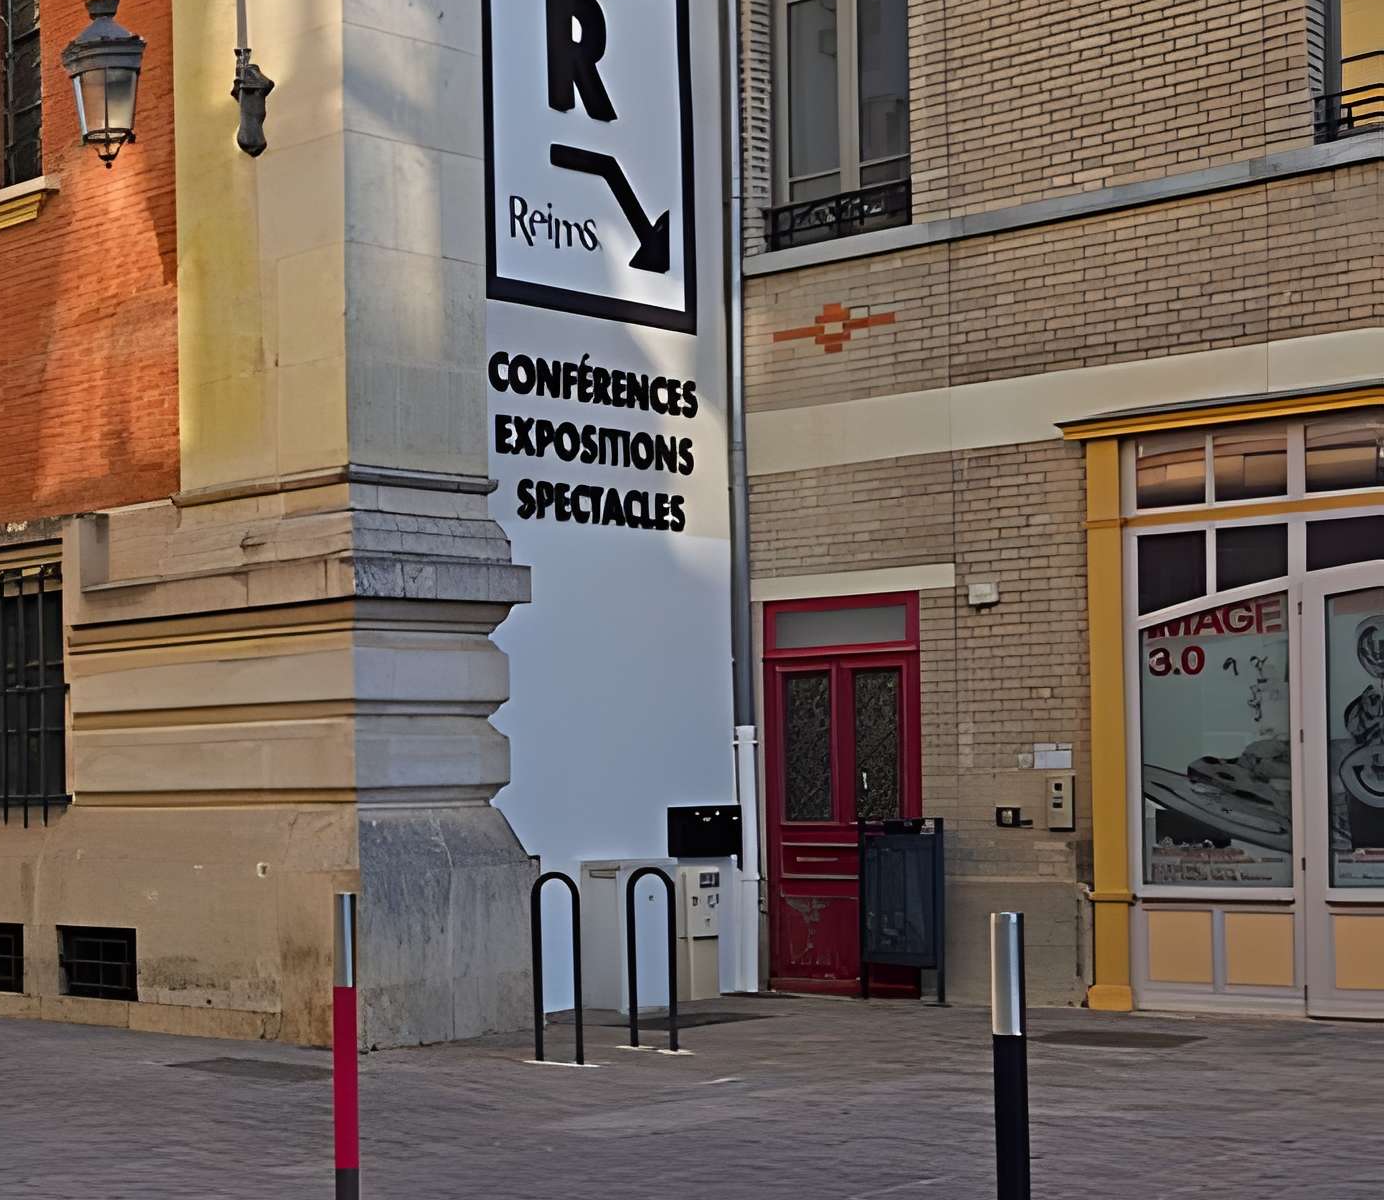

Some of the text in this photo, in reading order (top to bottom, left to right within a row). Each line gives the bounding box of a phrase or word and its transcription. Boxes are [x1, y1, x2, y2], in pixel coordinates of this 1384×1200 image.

[509, 195, 600, 251] Reims
[488, 351, 698, 418] CONFÉRENCES
[495, 414, 695, 476] EXPOSITIONS
[517, 478, 686, 532] SPECTACLES
[1147, 600, 1282, 639] MAGE
[1148, 645, 1206, 676] 3.0
